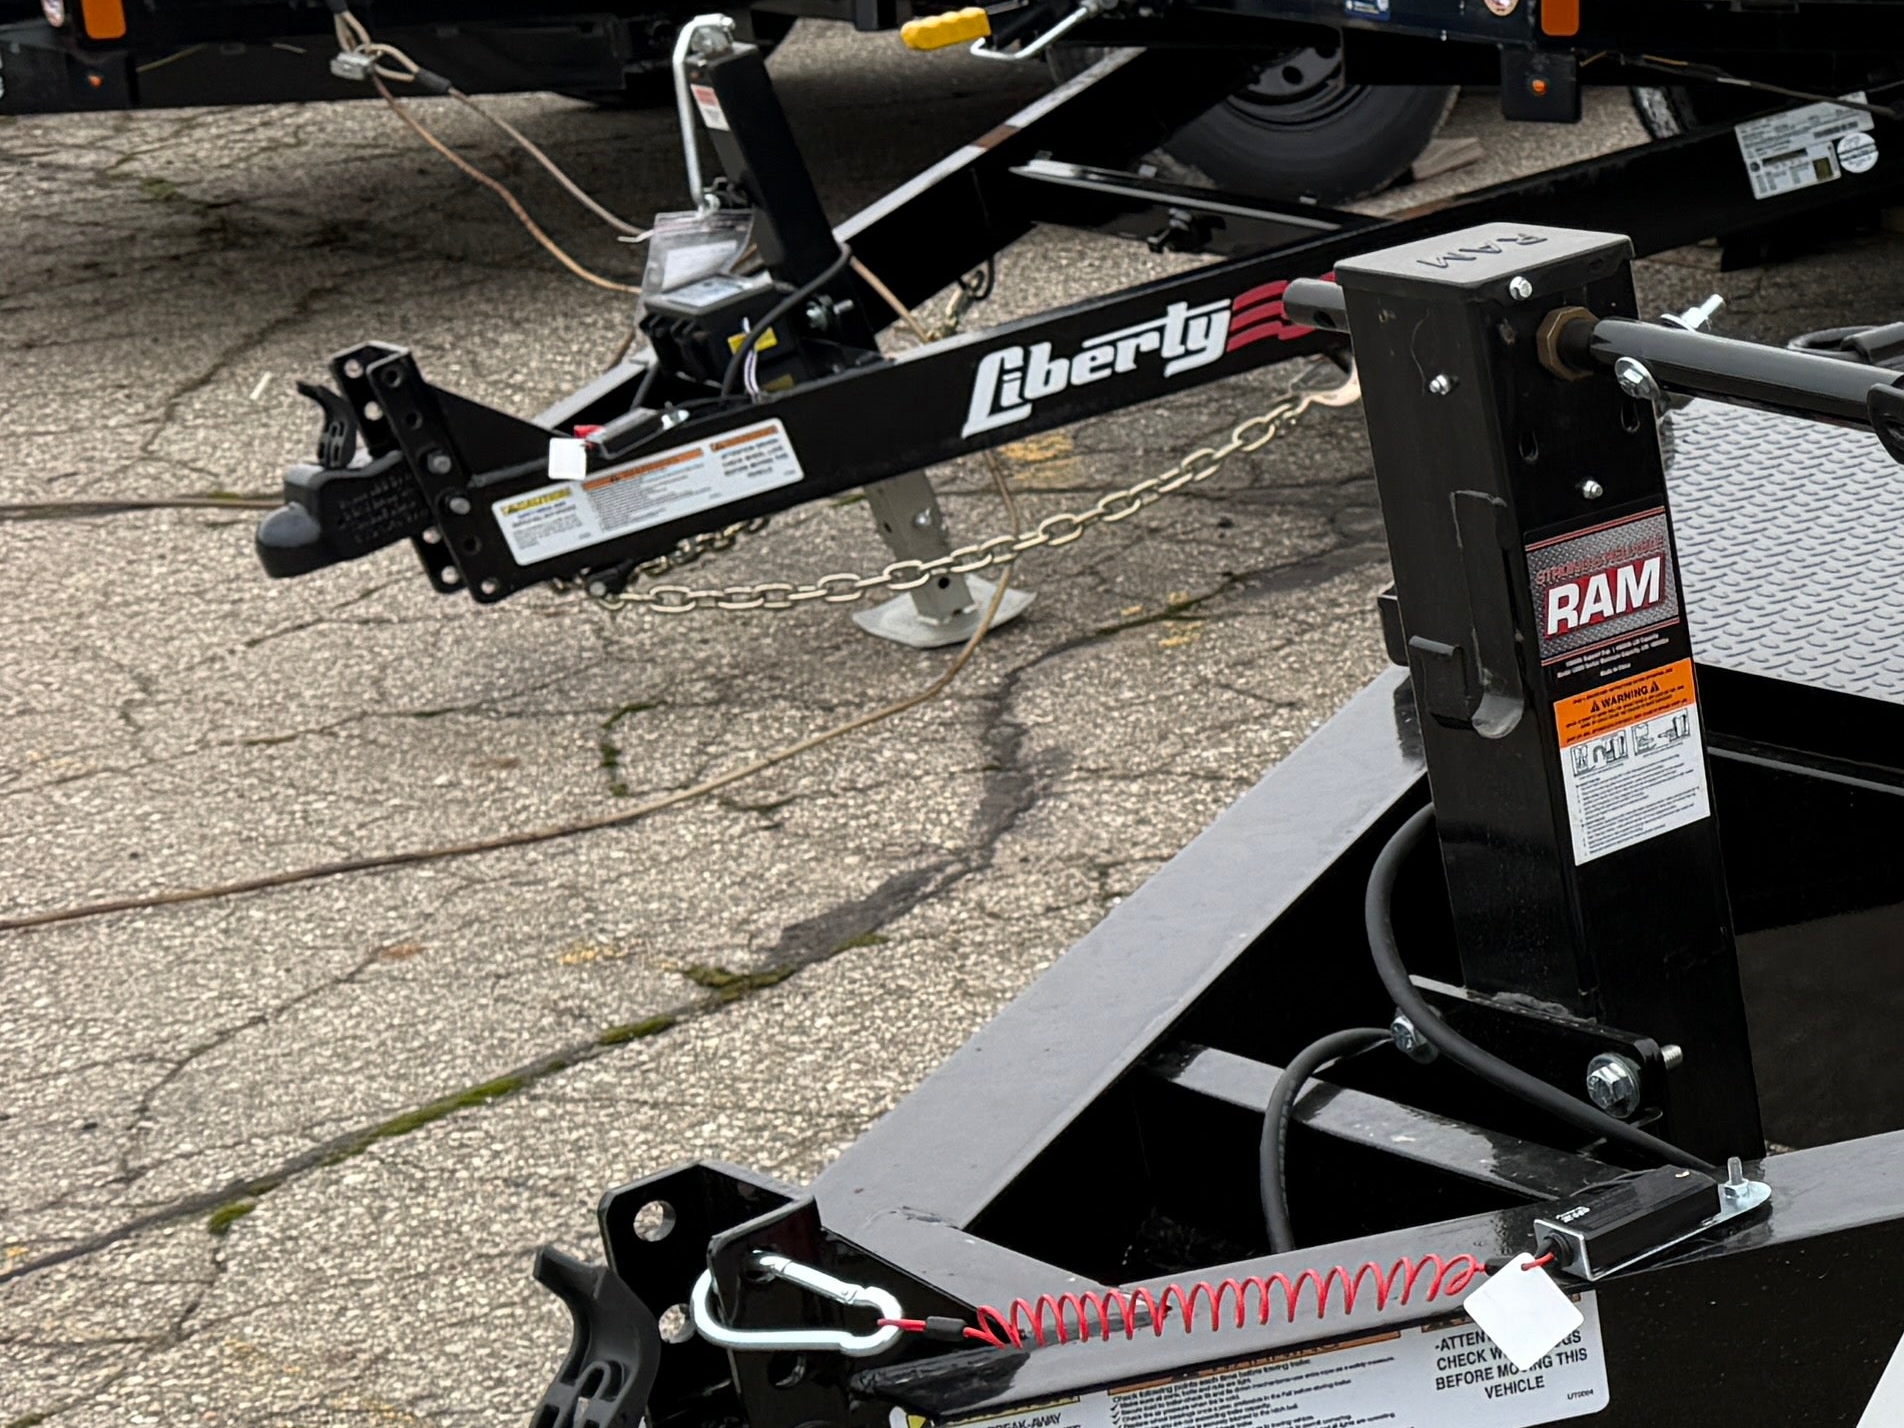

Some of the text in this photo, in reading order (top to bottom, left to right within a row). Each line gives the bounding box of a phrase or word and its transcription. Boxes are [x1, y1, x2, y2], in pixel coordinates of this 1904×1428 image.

[961, 297, 1232, 440] Liberty
[1547, 556, 1661, 636] RAM
[1601, 685, 1649, 709] WARNING
[1435, 1368, 1494, 1390] BEFORE
[1555, 1348, 1588, 1365] THIS
[1437, 1350, 1486, 1370] CHECK
[1485, 1376, 1545, 1399] VEHICLE
